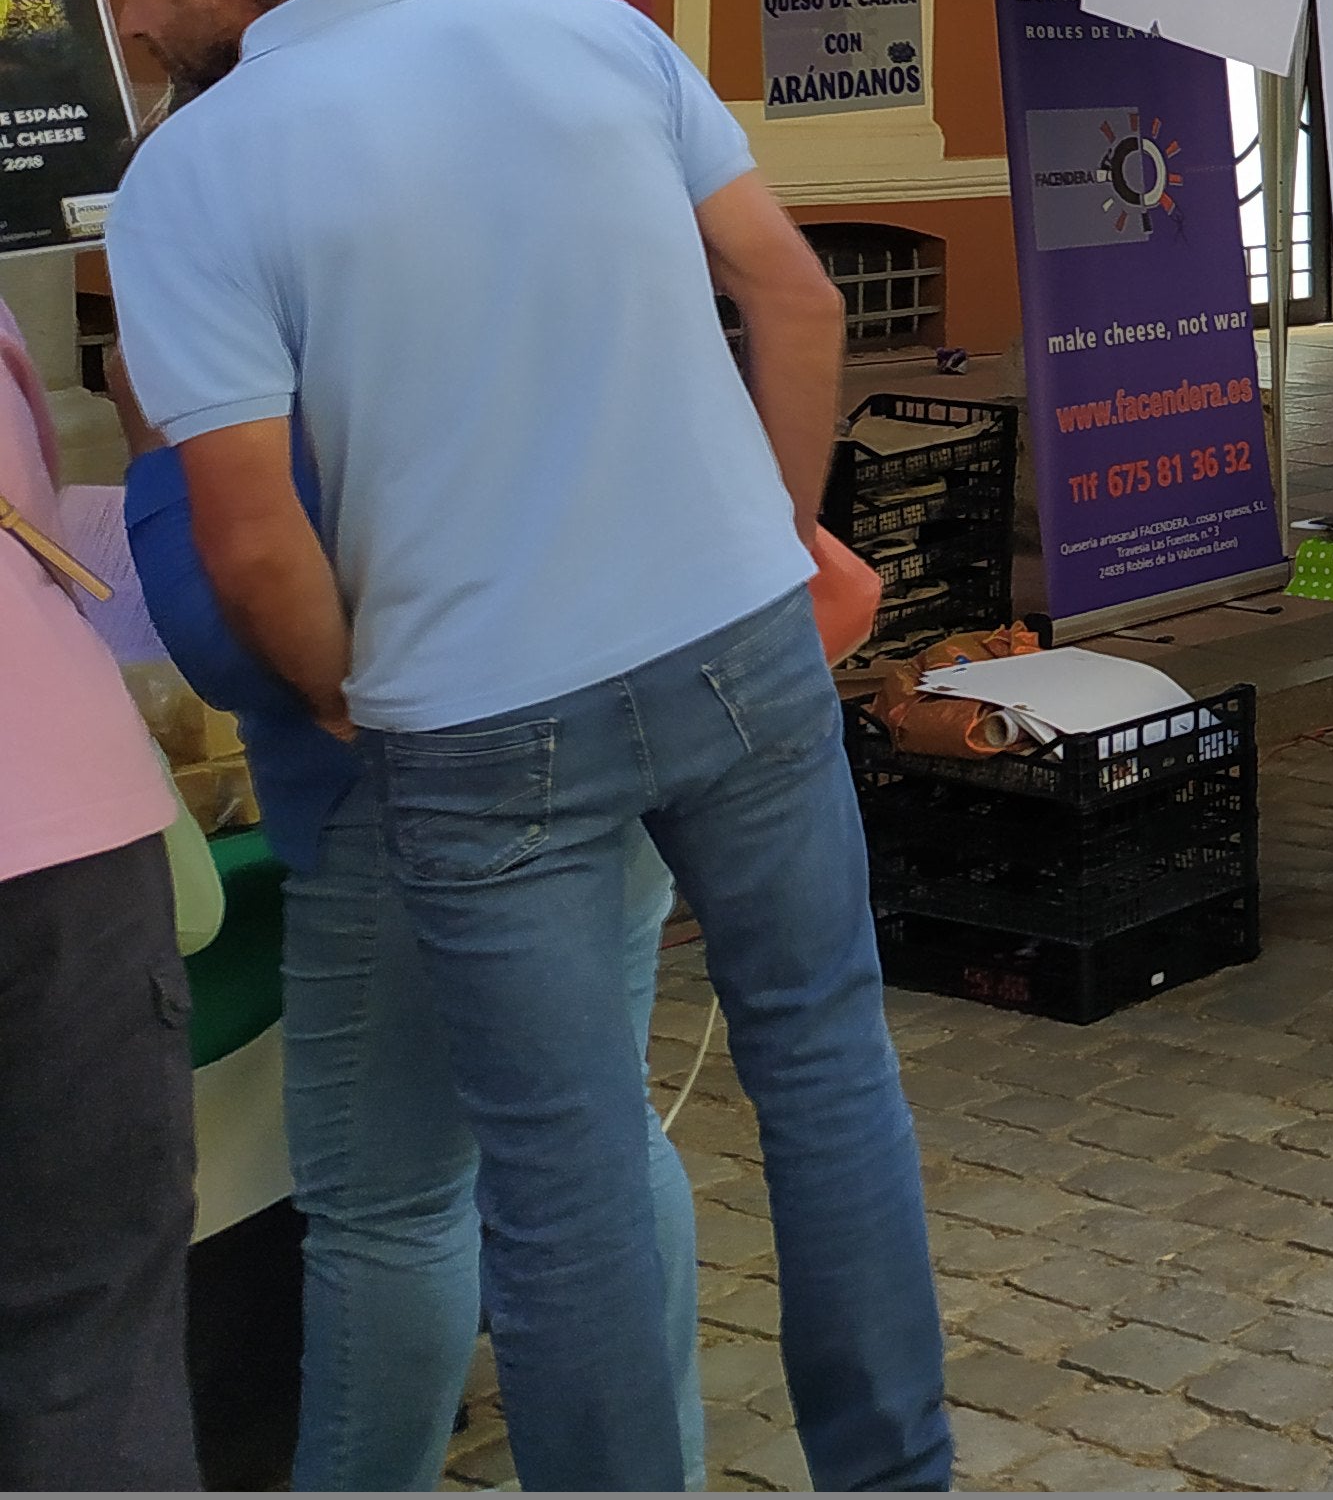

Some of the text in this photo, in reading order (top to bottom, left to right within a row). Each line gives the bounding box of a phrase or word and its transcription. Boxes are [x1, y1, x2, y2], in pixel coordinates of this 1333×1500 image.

[824, 32, 863, 54] CON
[1025, 25, 1084, 39] ROBLES
[1091, 25, 1110, 38] DE
[1117, 26, 1136, 38] LA
[768, 64, 920, 106] ARÁNDANOS
[0, 104, 89, 126] E ESPAÑA
[16, 127, 86, 147] CHEESE
[2, 155, 44, 172] 2018
[1047, 311, 1247, 354] make cheese, not war
[1055, 377, 1253, 433] www.facendera.es
[1068, 441, 1252, 503] Tlf 675 81 36 32
[1214, 525, 1220, 537] 3
[1126, 558, 1154, 572] Robles
[1155, 553, 1166, 565] de
[1167, 552, 1176, 563] la
